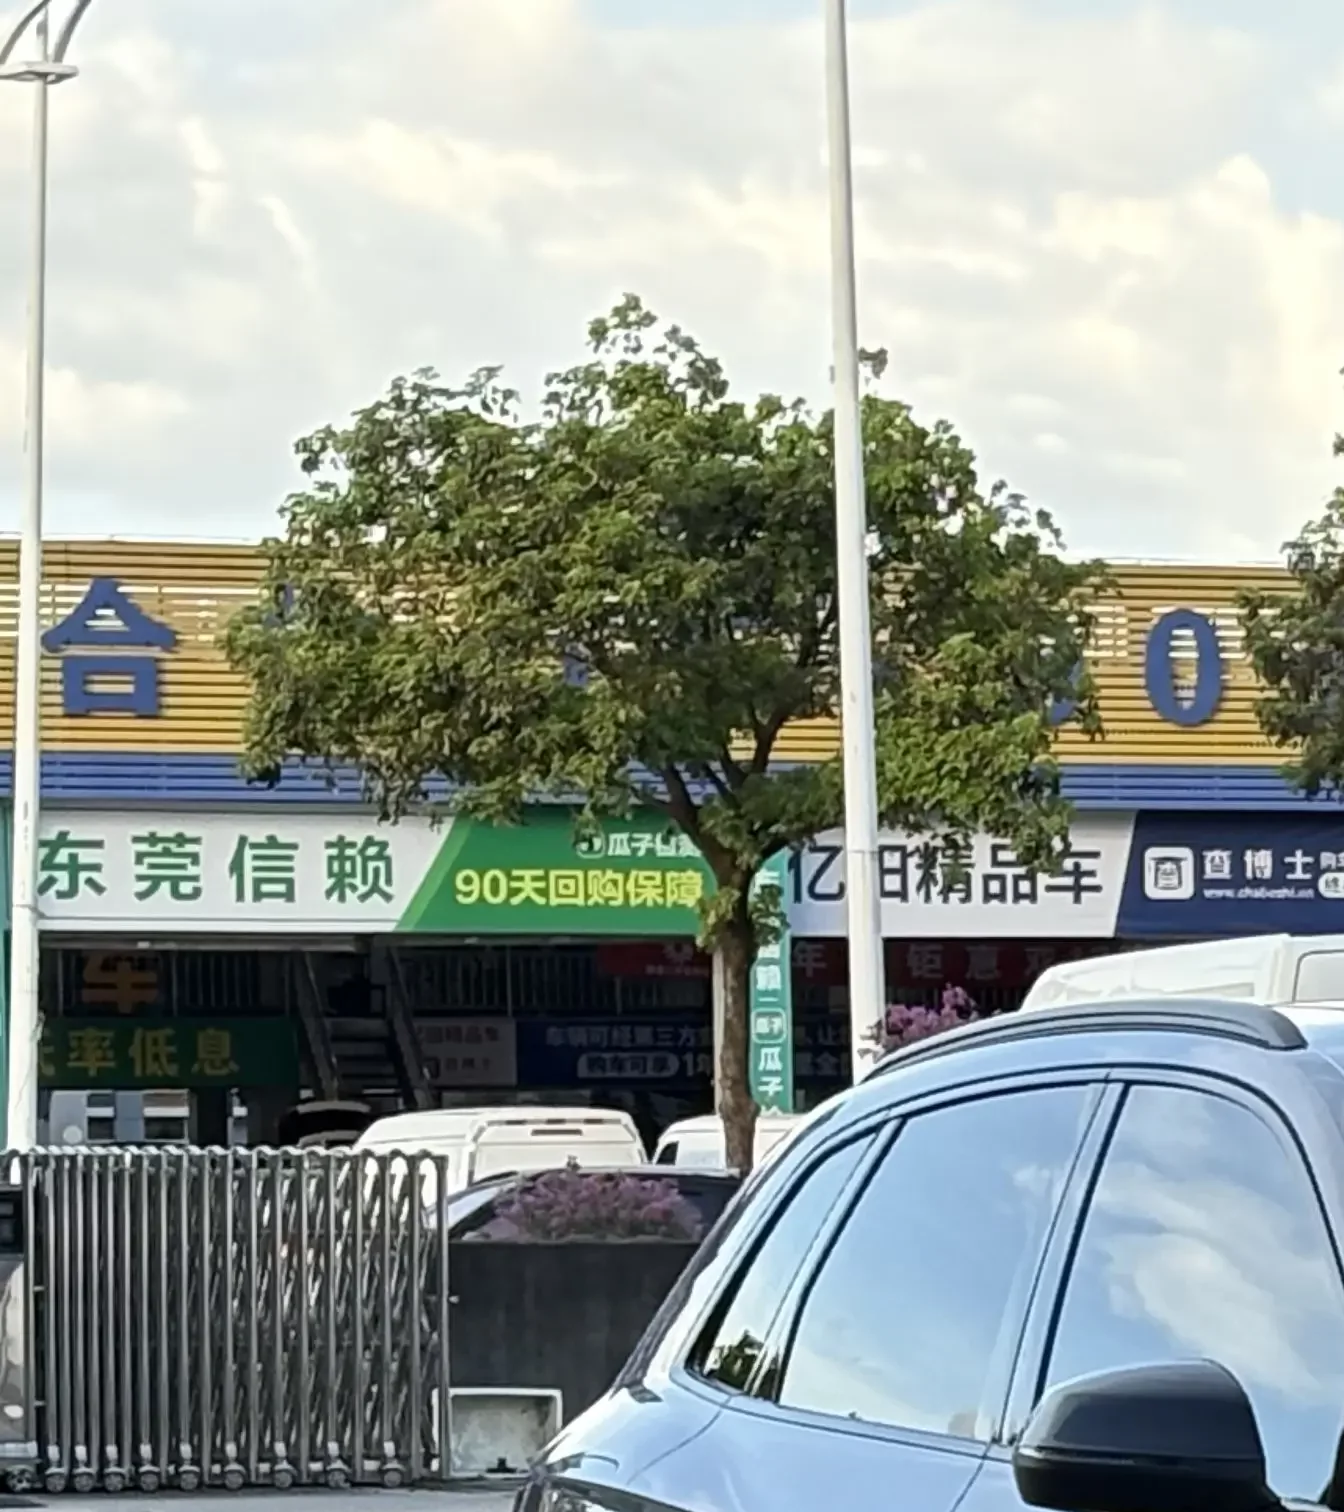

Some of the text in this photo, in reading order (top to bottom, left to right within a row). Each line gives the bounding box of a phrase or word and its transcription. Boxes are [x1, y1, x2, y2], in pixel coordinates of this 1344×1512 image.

[37, 830, 395, 904] 东莞信赖
[1202, 848, 1315, 880] 查博士
[455, 868, 703, 908] 90天回购保障
